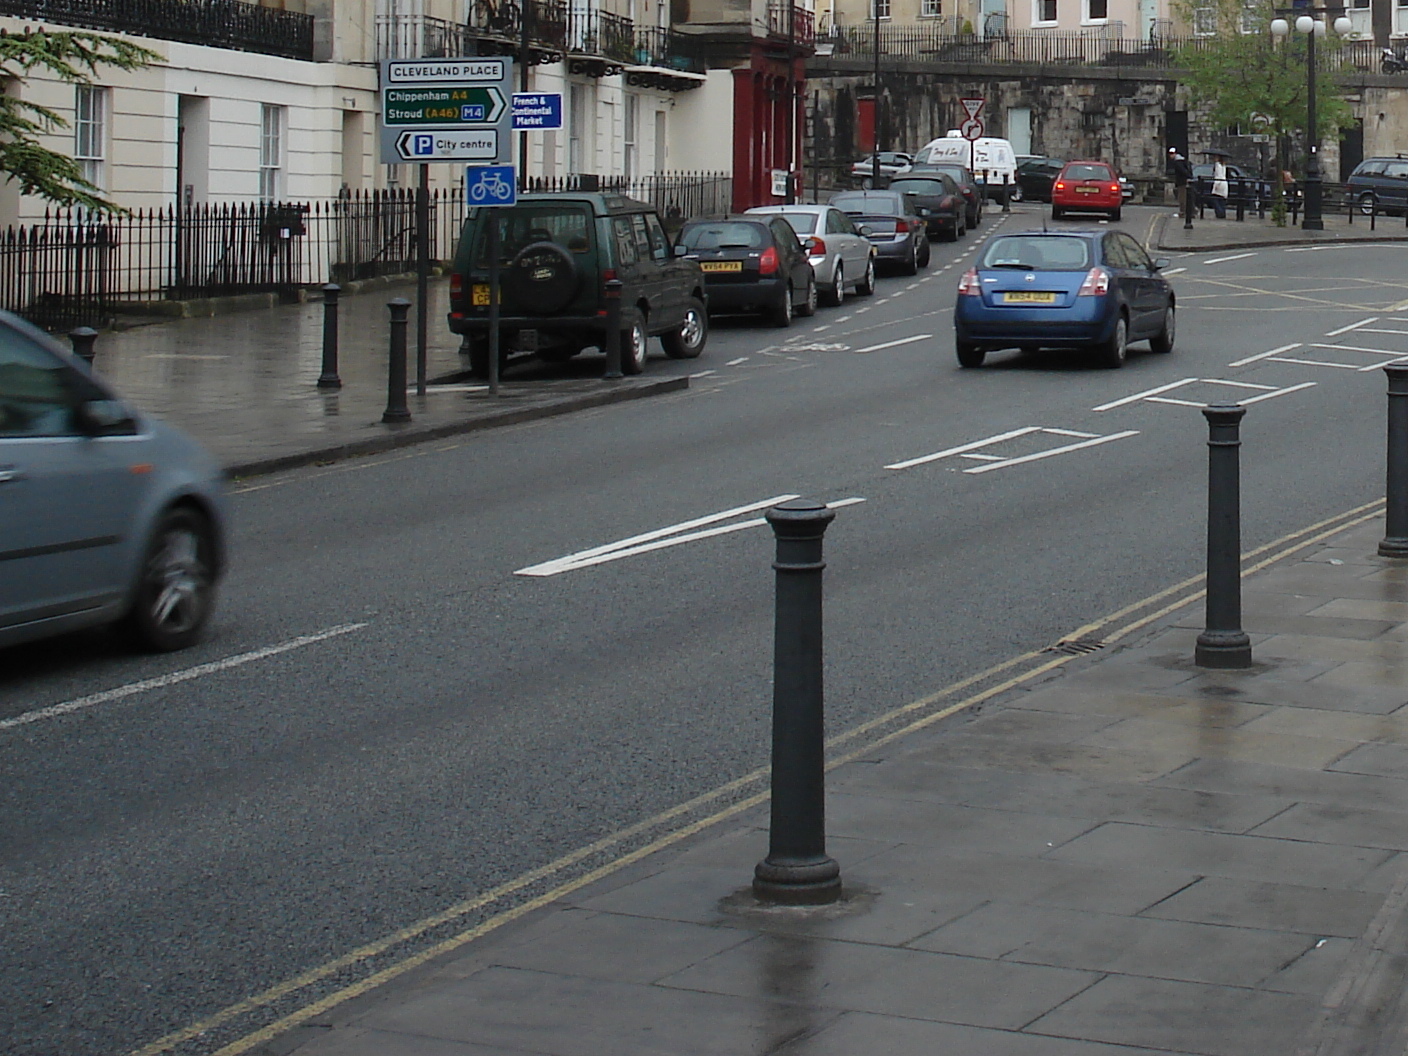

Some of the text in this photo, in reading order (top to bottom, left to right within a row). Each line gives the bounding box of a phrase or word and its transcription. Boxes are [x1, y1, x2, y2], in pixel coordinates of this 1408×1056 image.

[394, 65, 498, 77] CLEVELAND PLACE
[388, 90, 468, 102] Chippenham A4
[513, 96, 539, 105] French
[388, 107, 482, 119] Stroud (A46) M4
[516, 116, 544, 126] Market
[436, 139, 457, 150] City
[460, 140, 493, 149] centre
